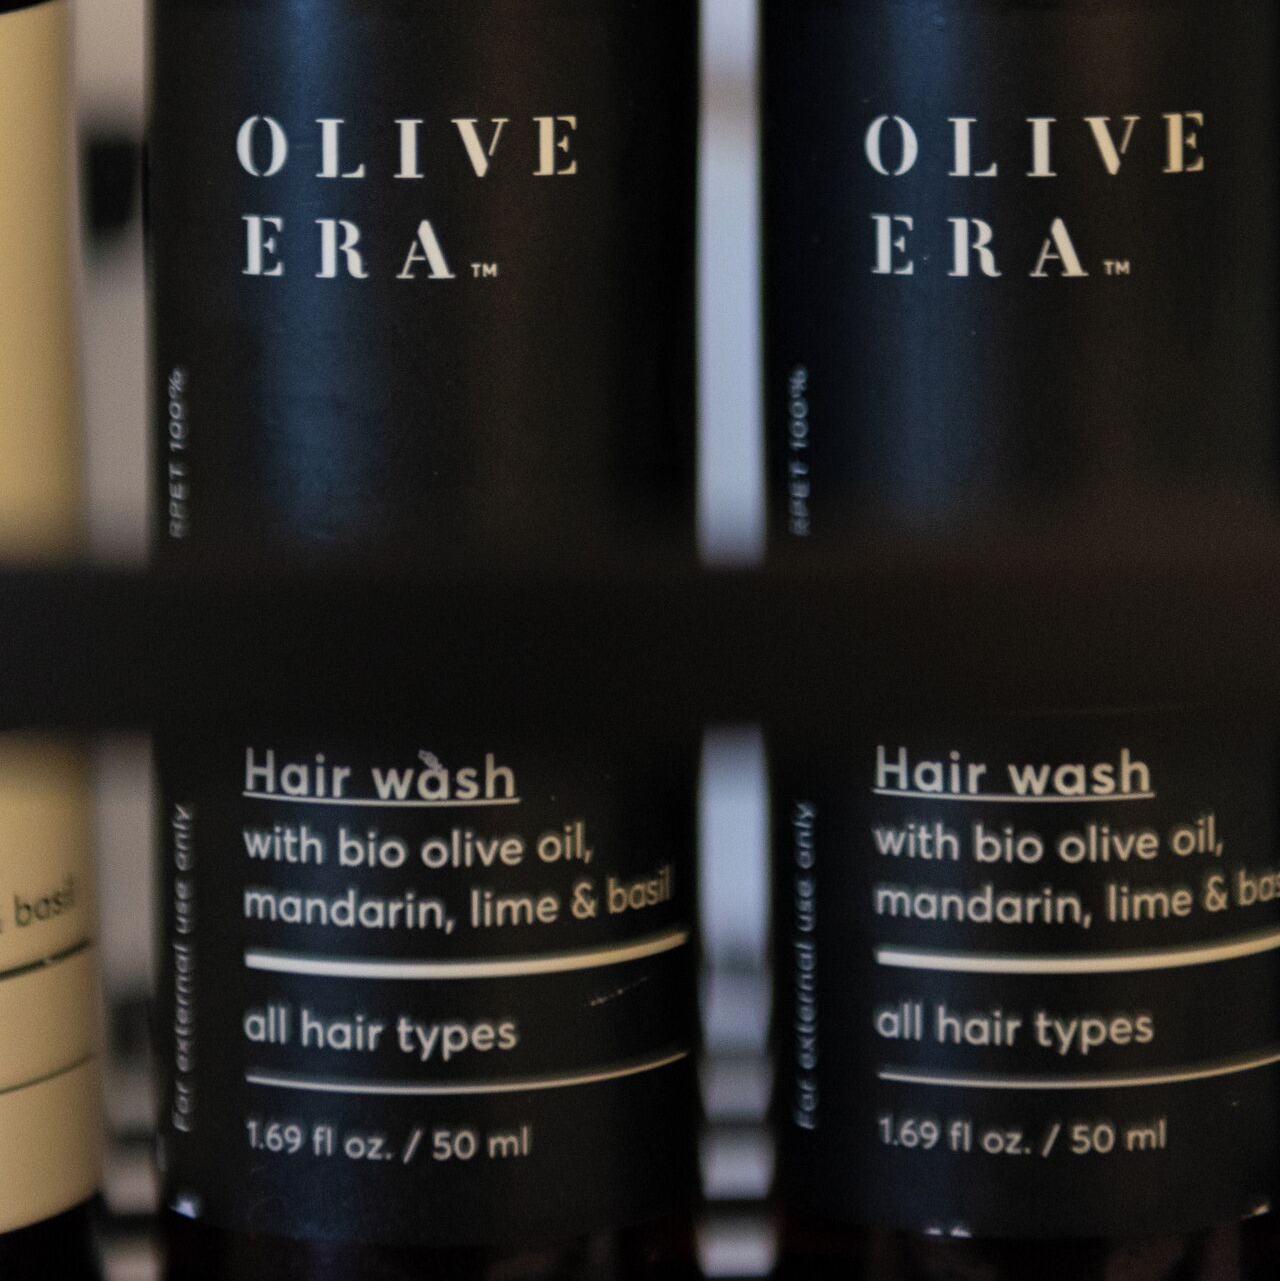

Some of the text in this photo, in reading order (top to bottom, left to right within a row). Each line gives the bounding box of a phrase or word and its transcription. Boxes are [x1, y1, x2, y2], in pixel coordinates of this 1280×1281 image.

[236, 115, 578, 178] OLIVE
[864, 111, 1205, 177] OLIVE
[168, 368, 184, 452] 100%
[244, 748, 515, 800] Hair wash
[876, 746, 1151, 795] Hair wash
[244, 823, 591, 868] with bio olive oil,
[874, 814, 1222, 863] with bio olive oil,
[244, 866, 671, 933] mandarin, lime & basil
[875, 887, 1091, 929] mandarin,
[1109, 885, 1191, 920] lime
[1205, 880, 1227, 911] &
[173, 804, 194, 1133] For external use only
[793, 803, 815, 1129] For external use only
[244, 1007, 517, 1061] all hair types
[875, 1003, 1153, 1055] all hair types
[247, 1120, 529, 1163] 1.69 fl oz. / 50 ml
[879, 1117, 1166, 1157] 1.69 fl oz. / 50 ml
